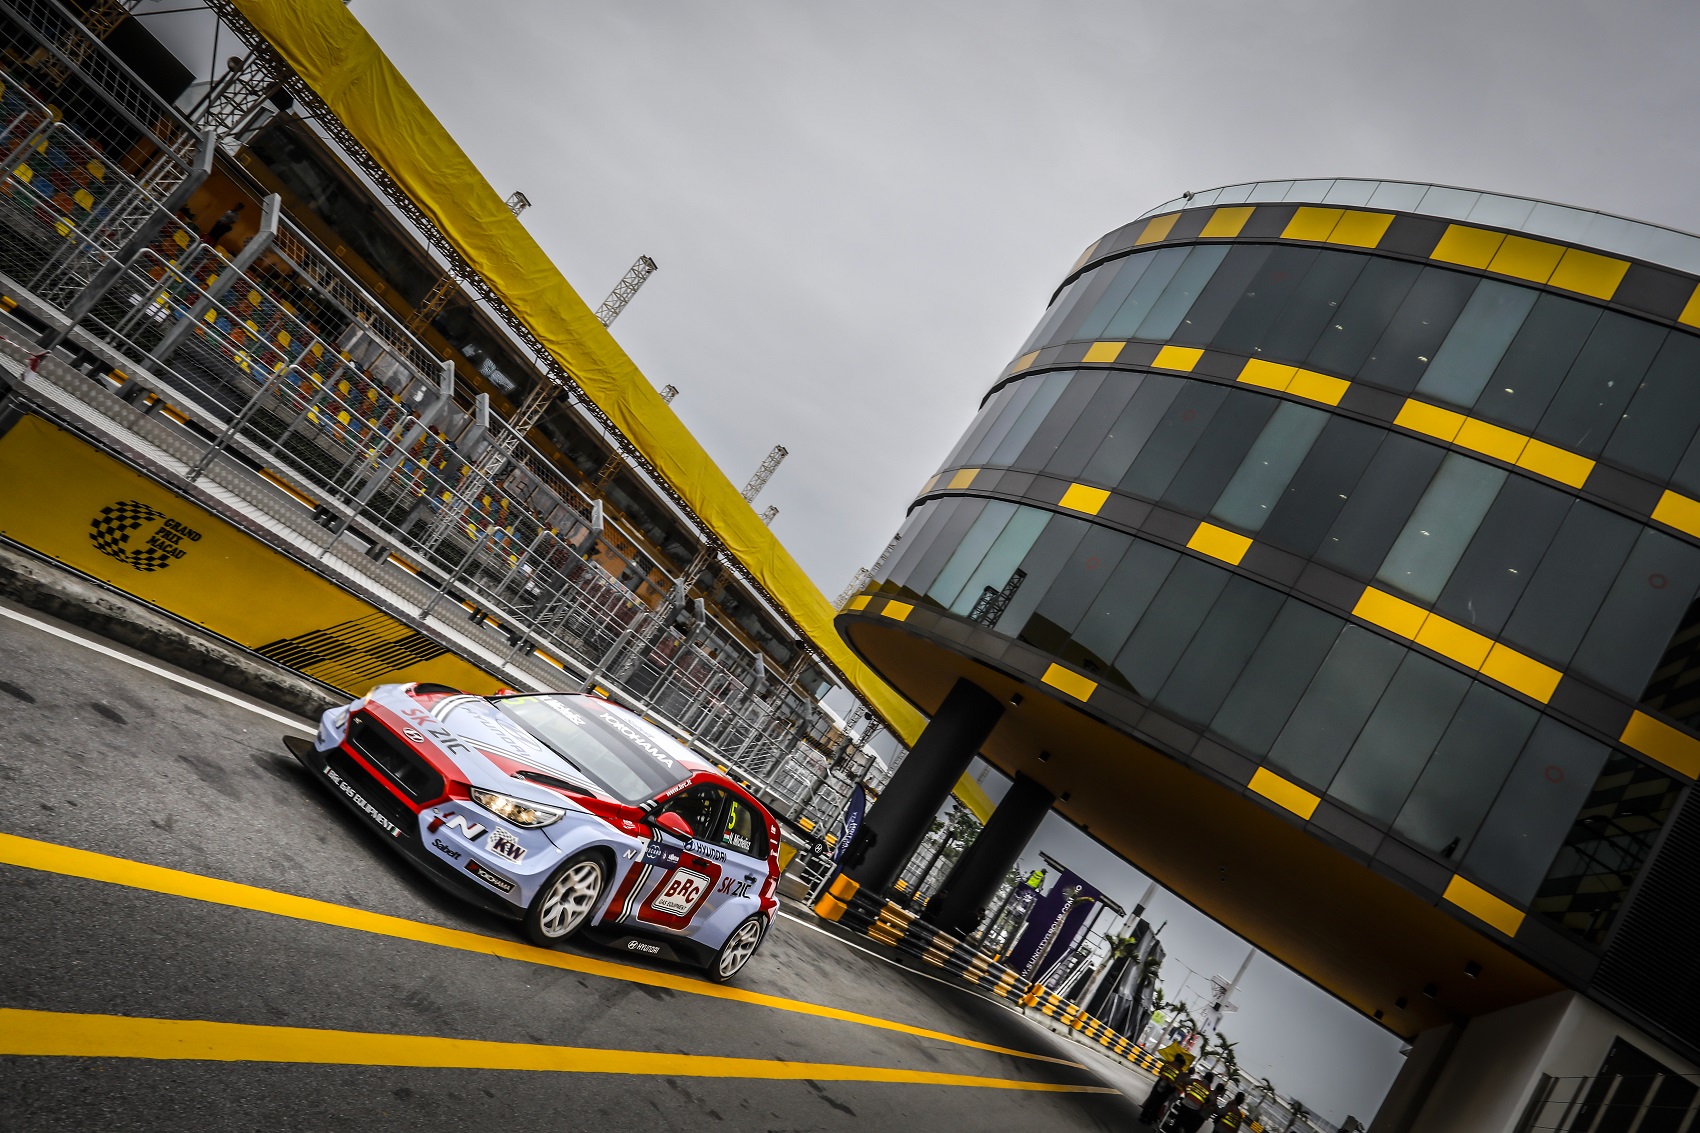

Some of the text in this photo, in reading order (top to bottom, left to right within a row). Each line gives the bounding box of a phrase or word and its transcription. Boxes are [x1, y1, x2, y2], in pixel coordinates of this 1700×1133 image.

[154, 526, 184, 546] PRIX
[164, 518, 202, 542] GRAND
[145, 535, 187, 559] MACAU
[400, 708, 472, 756] SK ZIC
[599, 712, 674, 769] YOKOHAMA
[728, 801, 739, 830] 5
[431, 838, 463, 861] Sabelt
[696, 842, 728, 863] HYUNDAI
[477, 868, 511, 892] YOKOHAMA
[663, 878, 700, 905] BRC
[717, 876, 752, 900] SK ZIC
